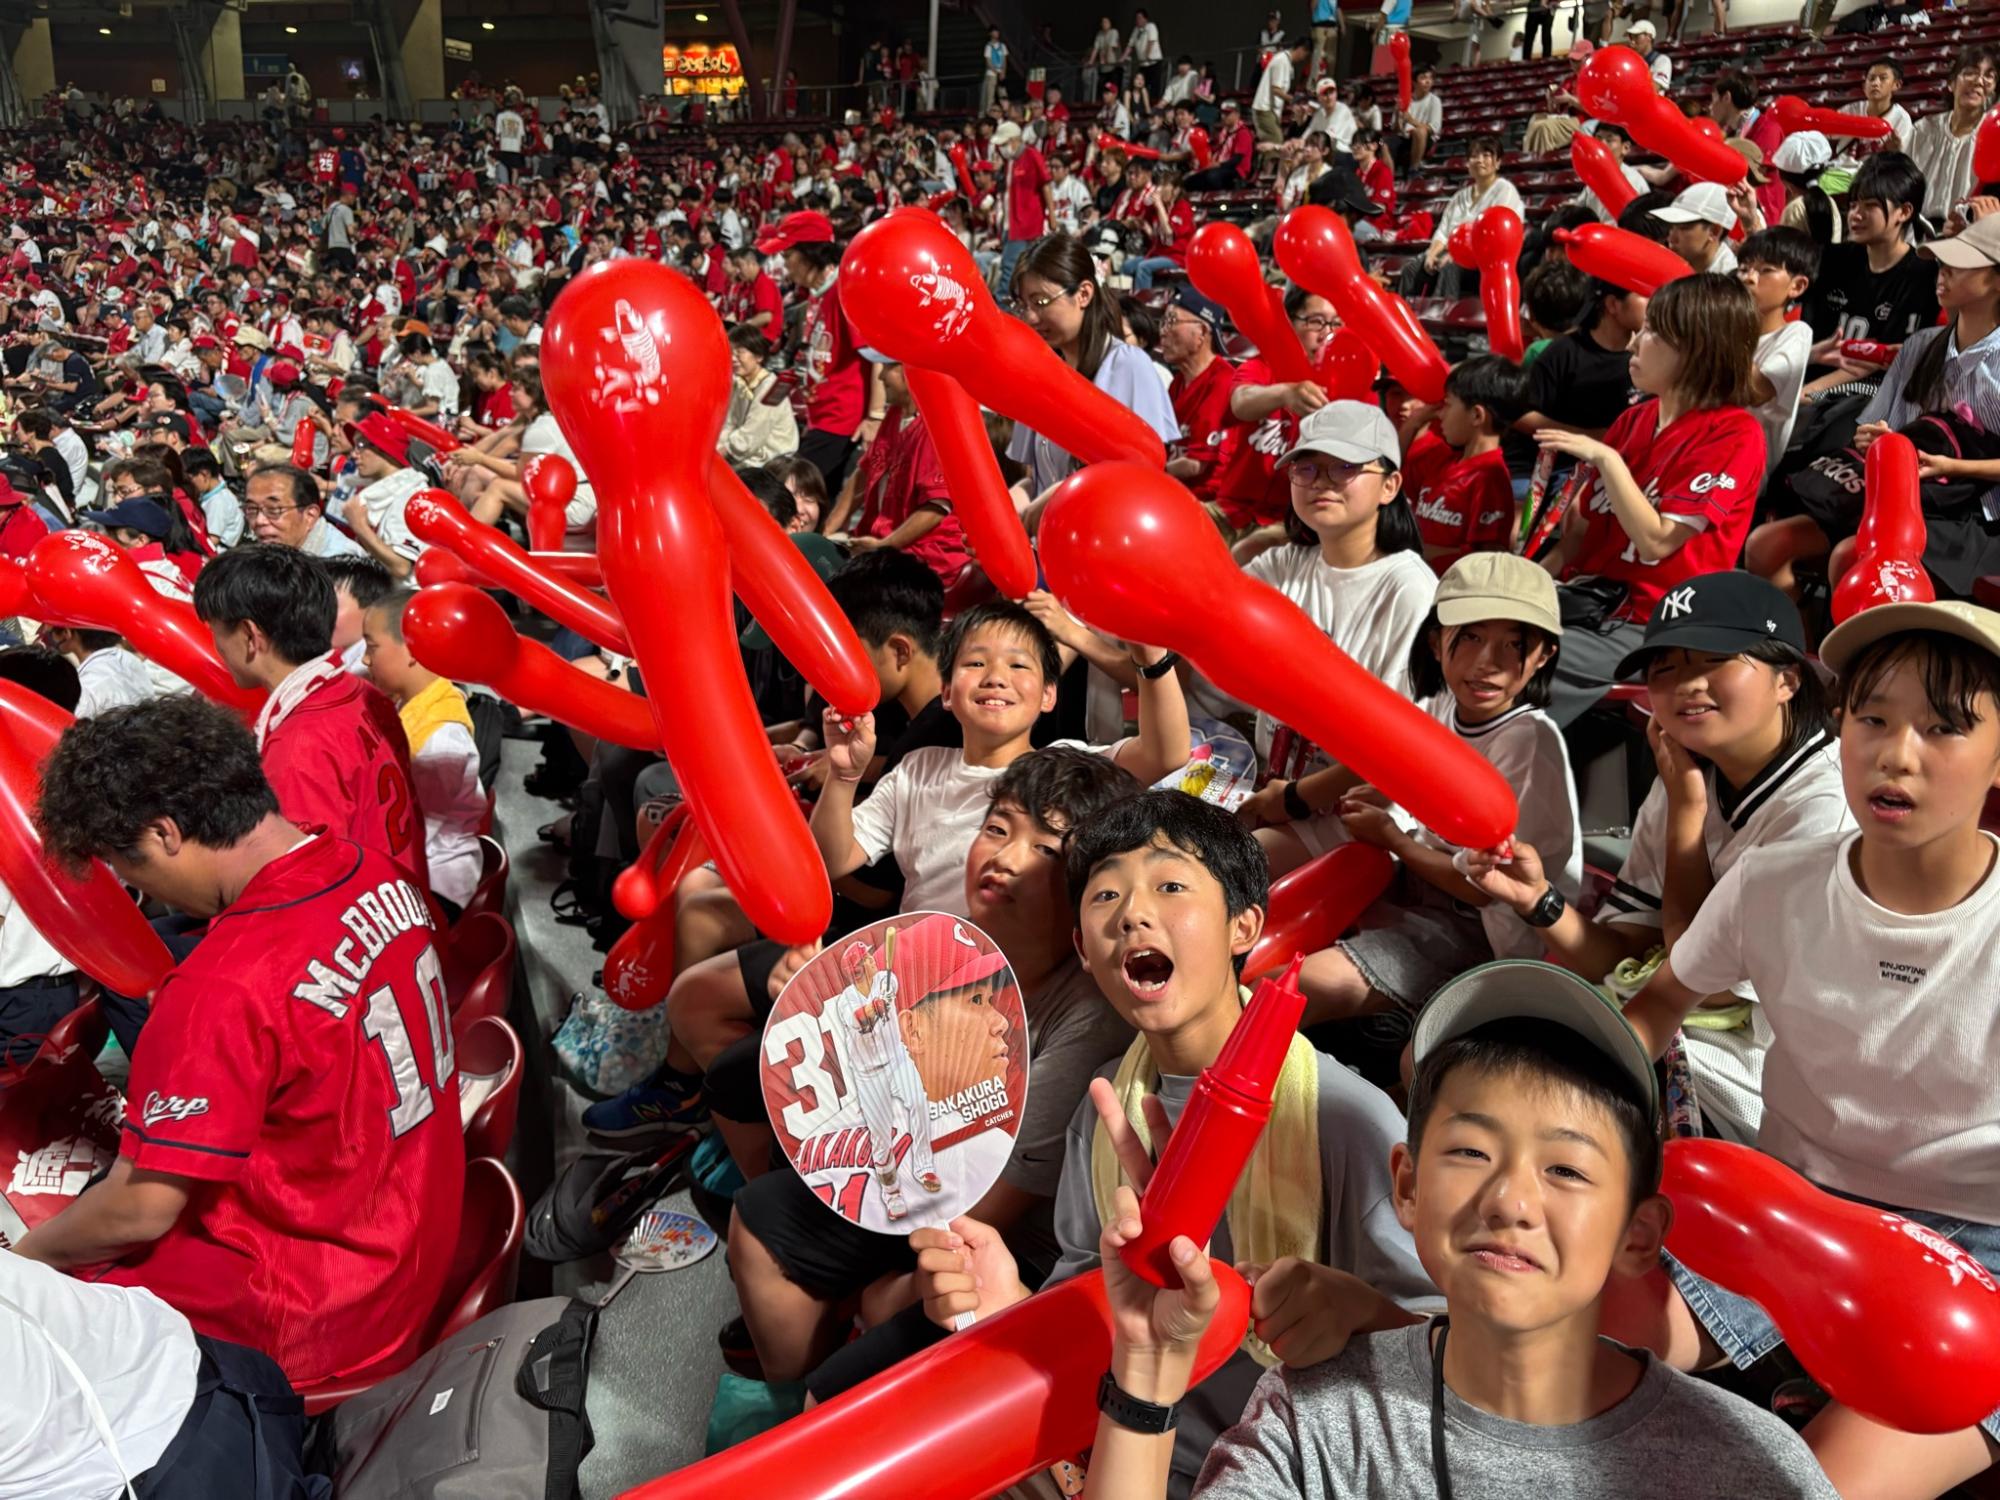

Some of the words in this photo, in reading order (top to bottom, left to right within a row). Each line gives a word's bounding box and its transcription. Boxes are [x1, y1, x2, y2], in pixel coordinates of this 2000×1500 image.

[319, 158, 333, 172] 25
[1661, 586, 1696, 621] NY
[1879, 961, 1926, 976] ENJOYING
[1881, 970, 1920, 984] MYSELF
[361, 942, 456, 1141] 10
[765, 994, 858, 1141] 31
[143, 1091, 210, 1128] Carp
[929, 1075, 1006, 1120] SAKAKURA
[961, 1090, 1009, 1123] SHOGO
[985, 1109, 1014, 1127] CATCHER
